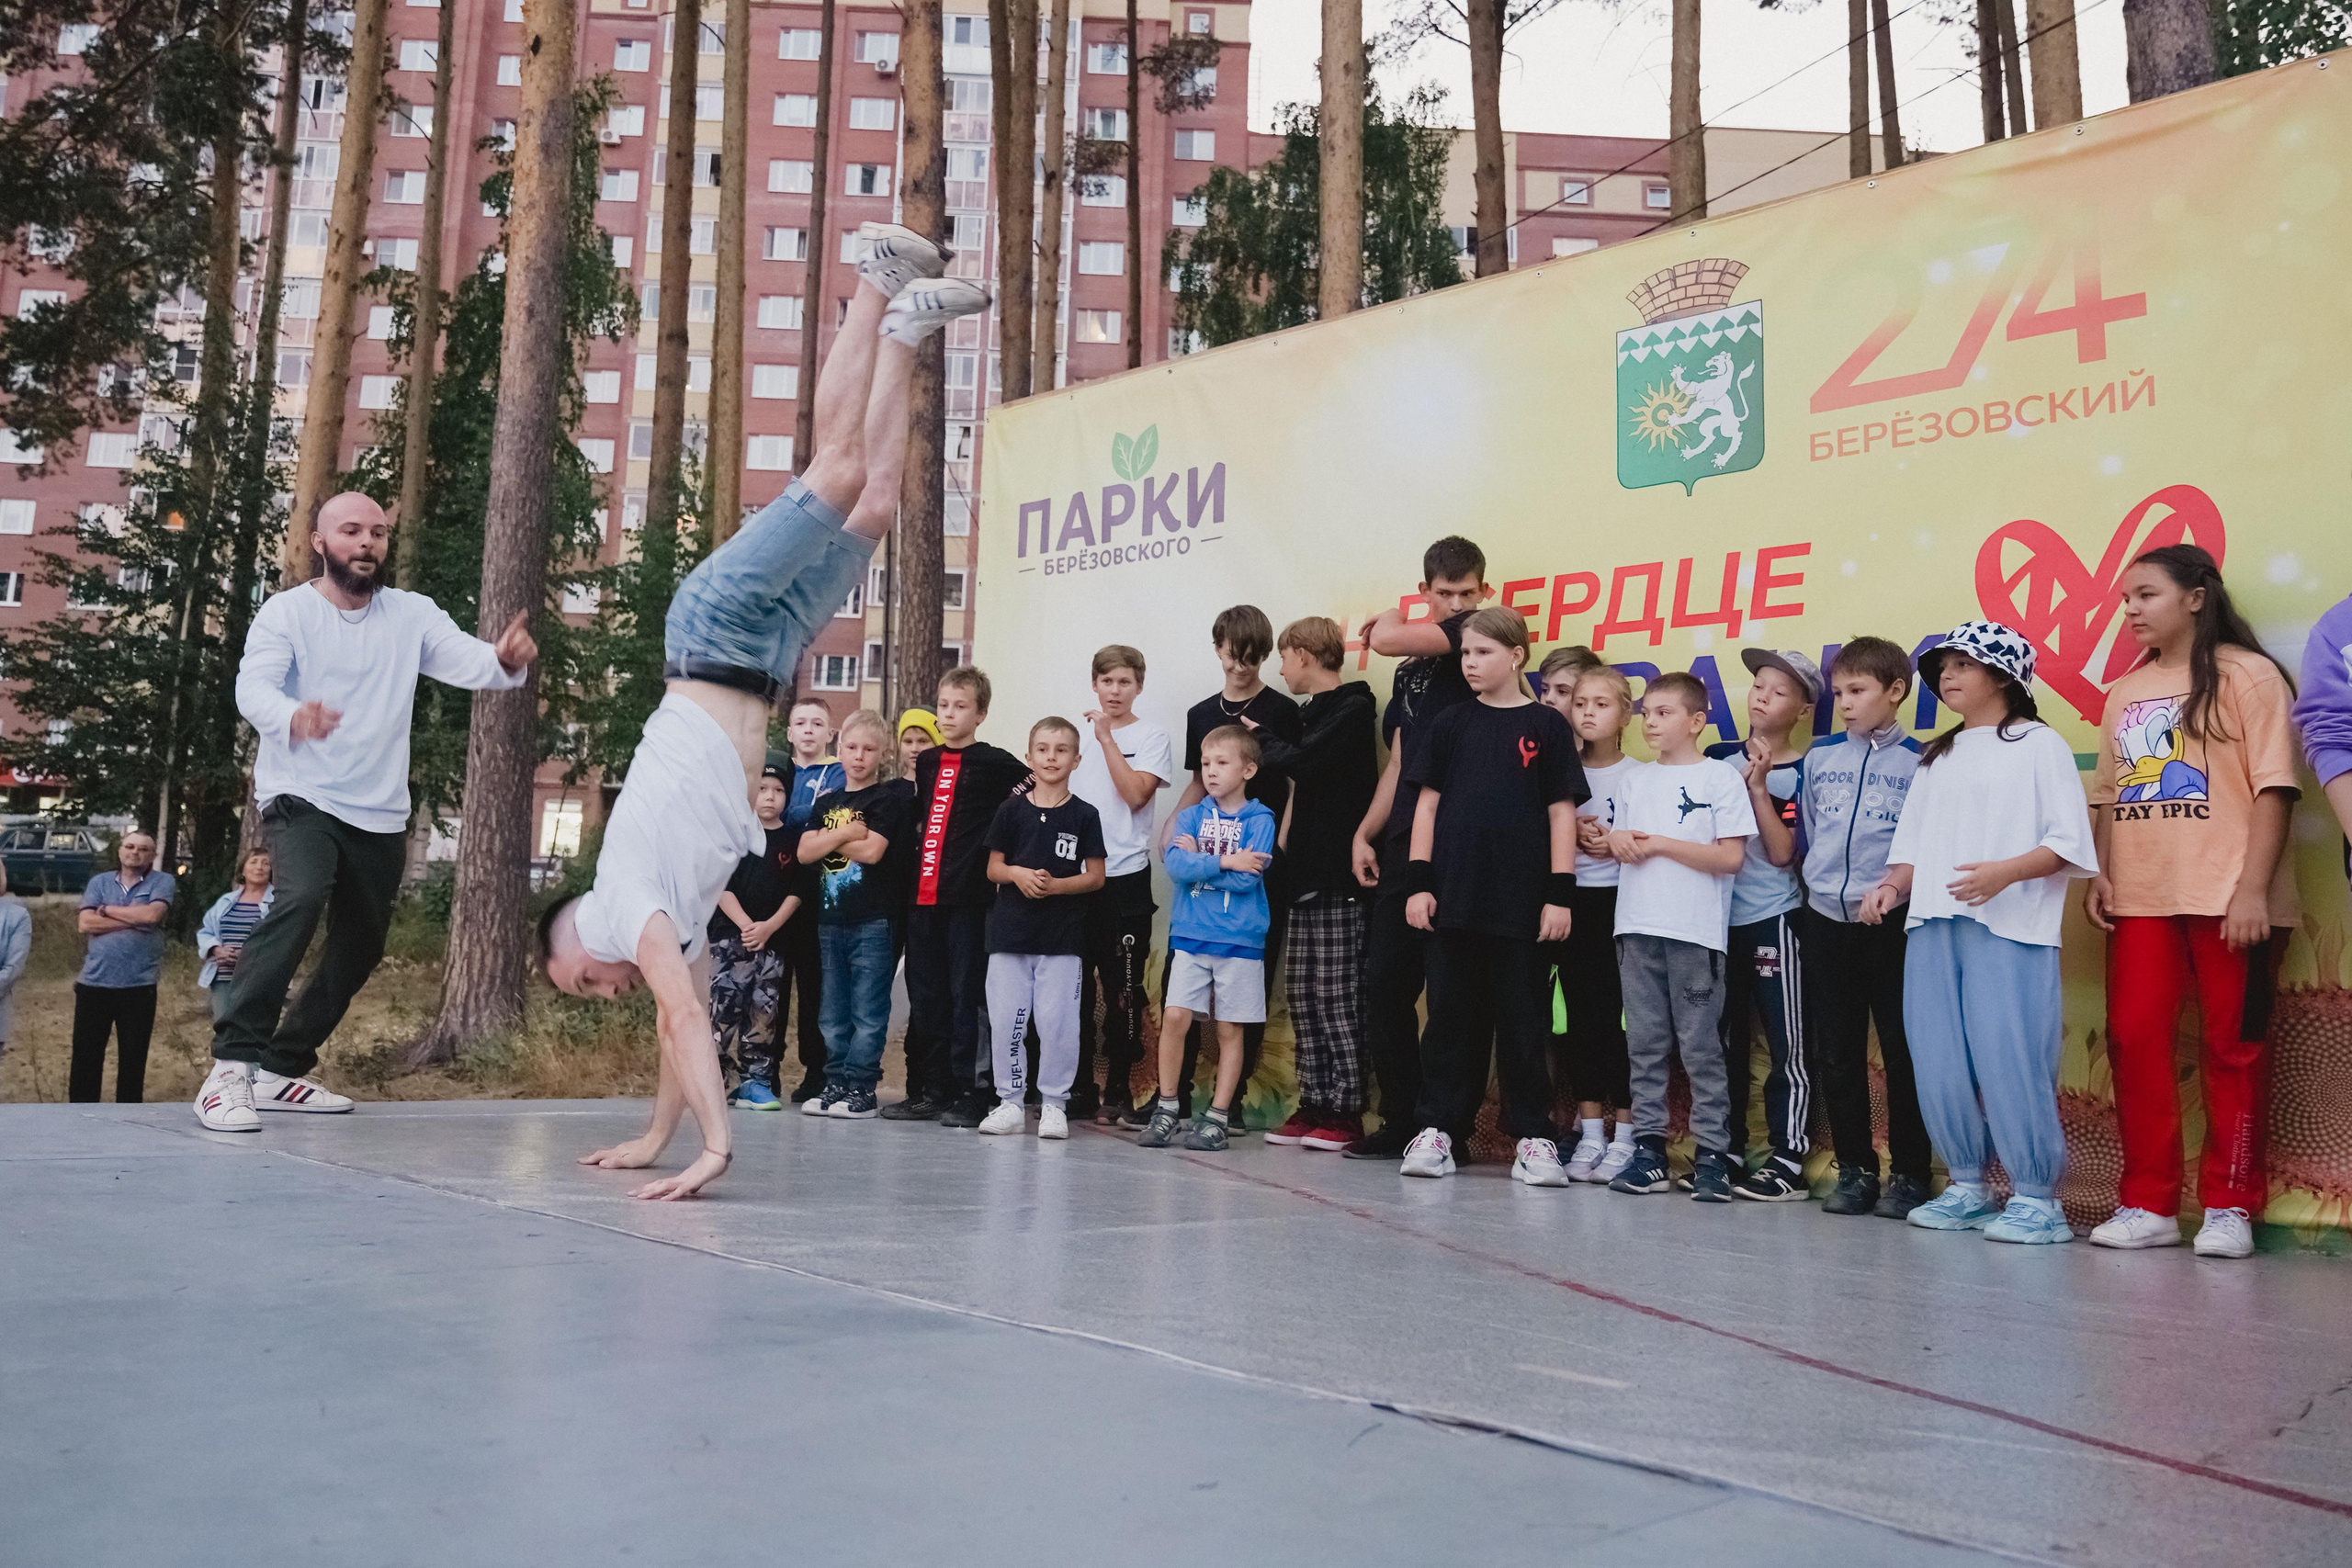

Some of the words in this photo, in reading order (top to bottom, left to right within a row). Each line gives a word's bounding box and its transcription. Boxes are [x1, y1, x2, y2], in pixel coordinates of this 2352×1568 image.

[1809, 228, 2147, 414] 274
[1809, 368, 2155, 462] БЕРЁЗОВСКИЙ
[1017, 461, 1226, 558] ПАРКИ
[1044, 536, 1191, 576] БЕРЁЗОВСКОГО
[1486, 542, 1812, 651] ЕРДЦЕ
[938, 768, 955, 789] ON
[1012, 782, 1027, 796] ON
[1023, 773, 1036, 786] YO
[1867, 773, 1912, 792] DIVISI
[928, 795, 950, 834] YOUR
[2113, 805, 2154, 821] TAY
[2161, 804, 2210, 819] EPIC
[922, 839, 937, 876] OWN
[1055, 838, 1077, 861] 01
[1011, 1008, 1026, 1057] MASTER
[1012, 1058, 1023, 1089] EVEL
